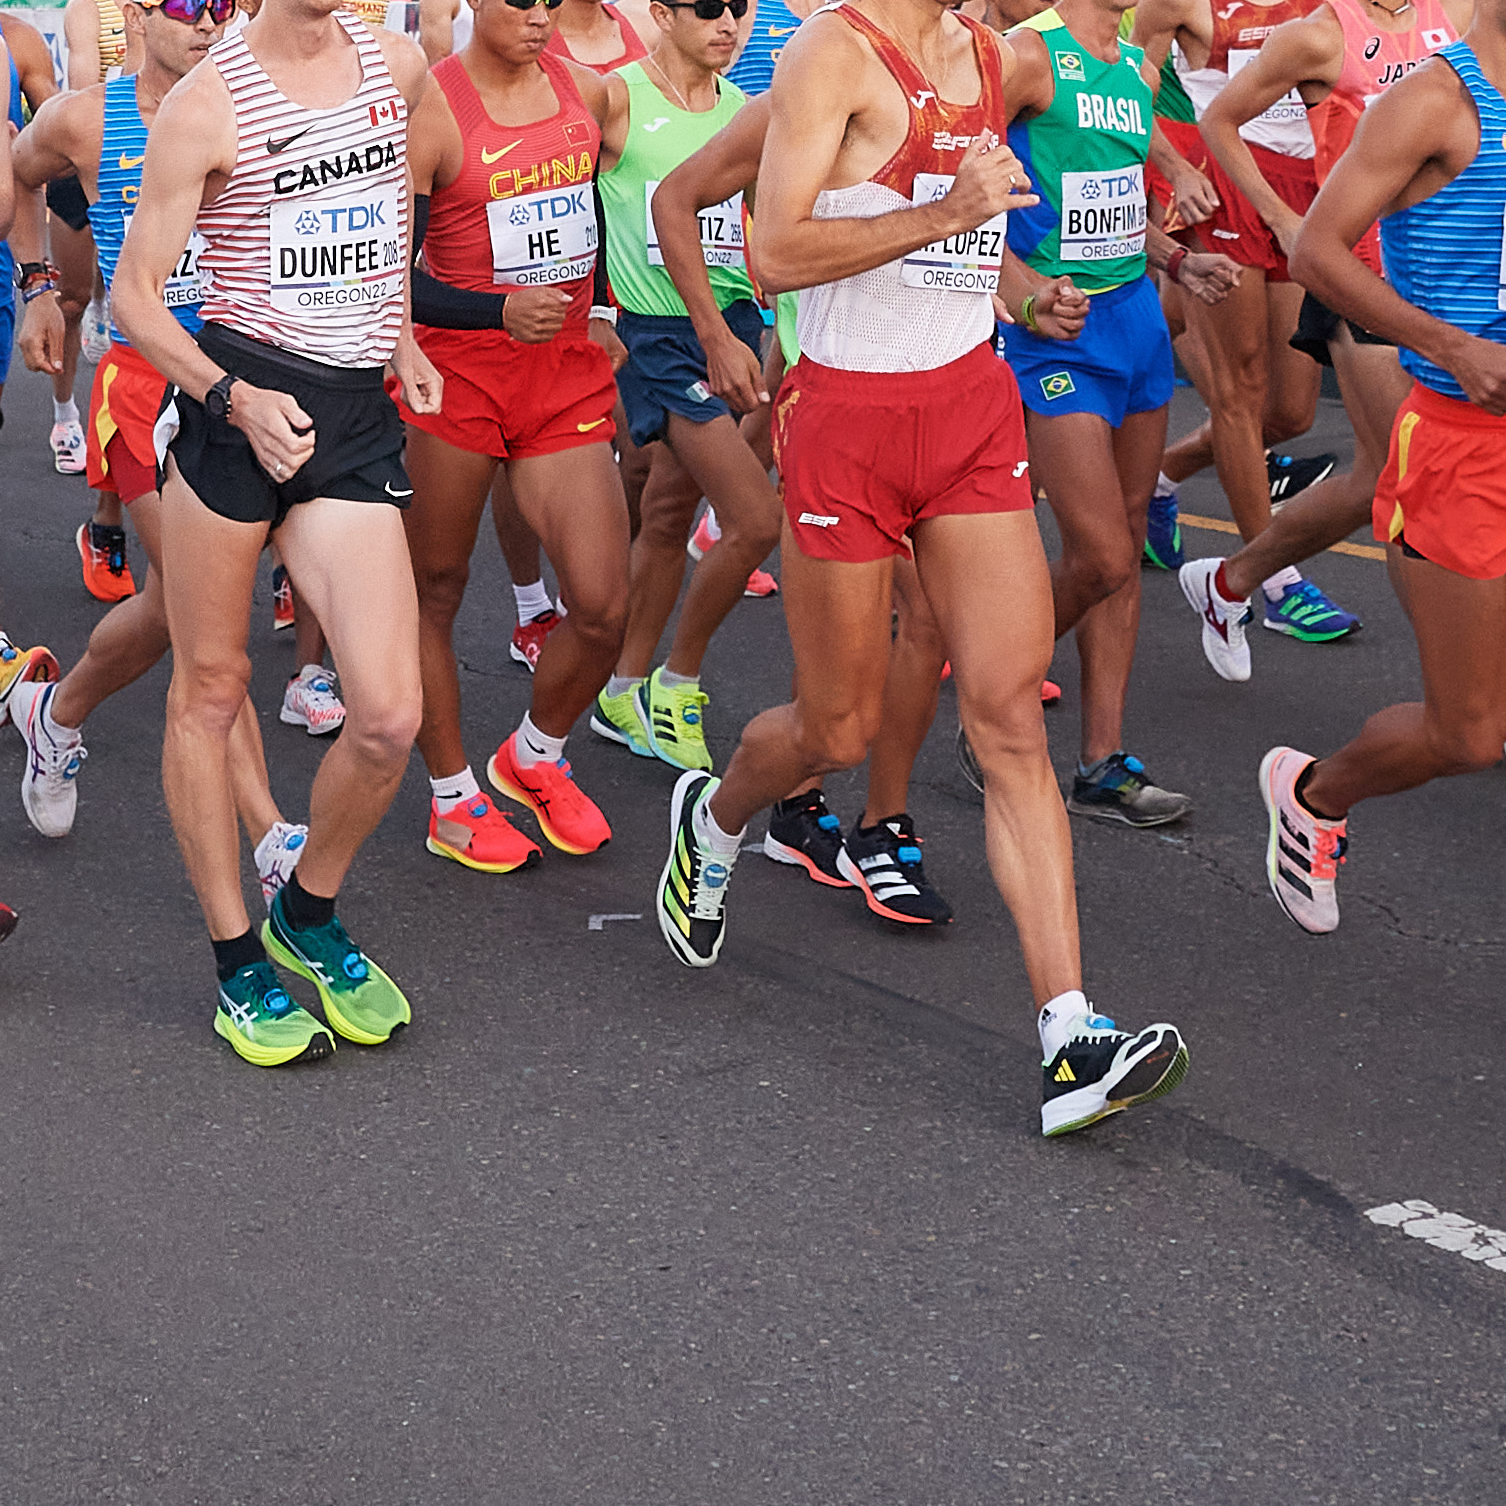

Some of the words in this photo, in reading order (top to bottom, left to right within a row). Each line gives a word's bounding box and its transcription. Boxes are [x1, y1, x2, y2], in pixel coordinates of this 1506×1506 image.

[1076, 92, 1147, 136] BRASIL
[273, 140, 398, 195] CANADA
[488, 151, 594, 200] CHINA
[1102, 172, 1139, 199] TDK
[320, 199, 387, 234] TDK
[528, 190, 588, 222] TDK
[1068, 203, 1137, 235] BONFIM
[279, 238, 379, 279] DUNFEE
[382, 240, 398, 267] 208
[527, 228, 562, 261] HE
[297, 281, 388, 307] OREGON22
